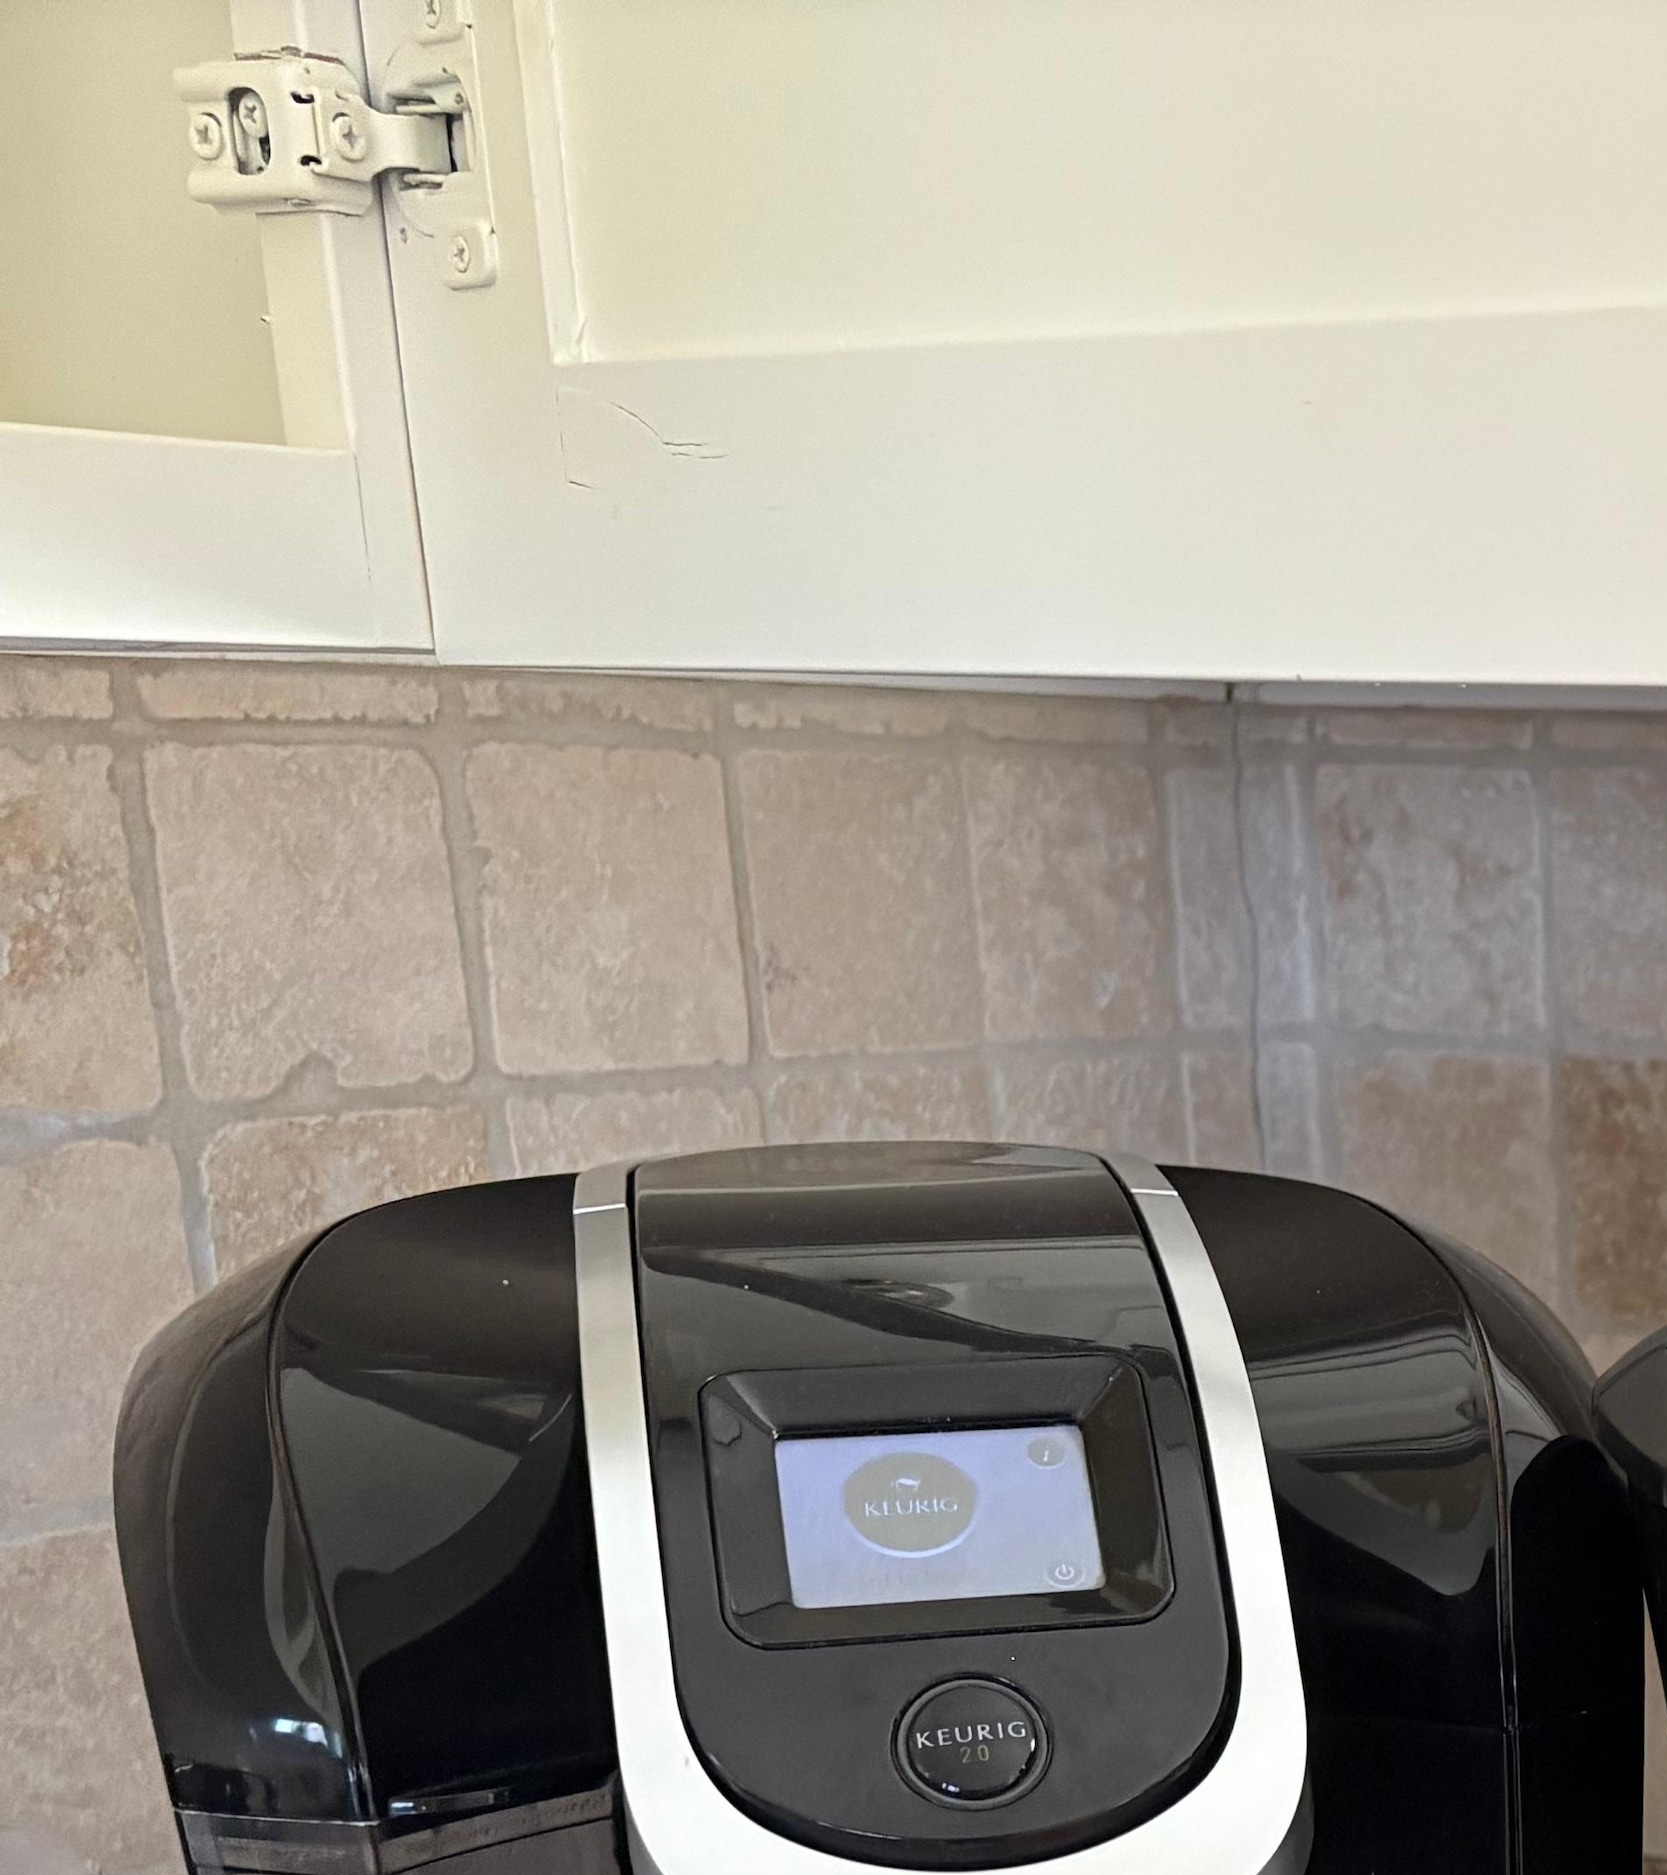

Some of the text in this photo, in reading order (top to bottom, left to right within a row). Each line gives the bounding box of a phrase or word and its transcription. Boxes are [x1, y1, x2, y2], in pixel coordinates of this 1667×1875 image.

[865, 1497, 958, 1517] KEURIG
[916, 1719, 1027, 1750] KEURIG
[961, 1744, 990, 1764] 2.0
